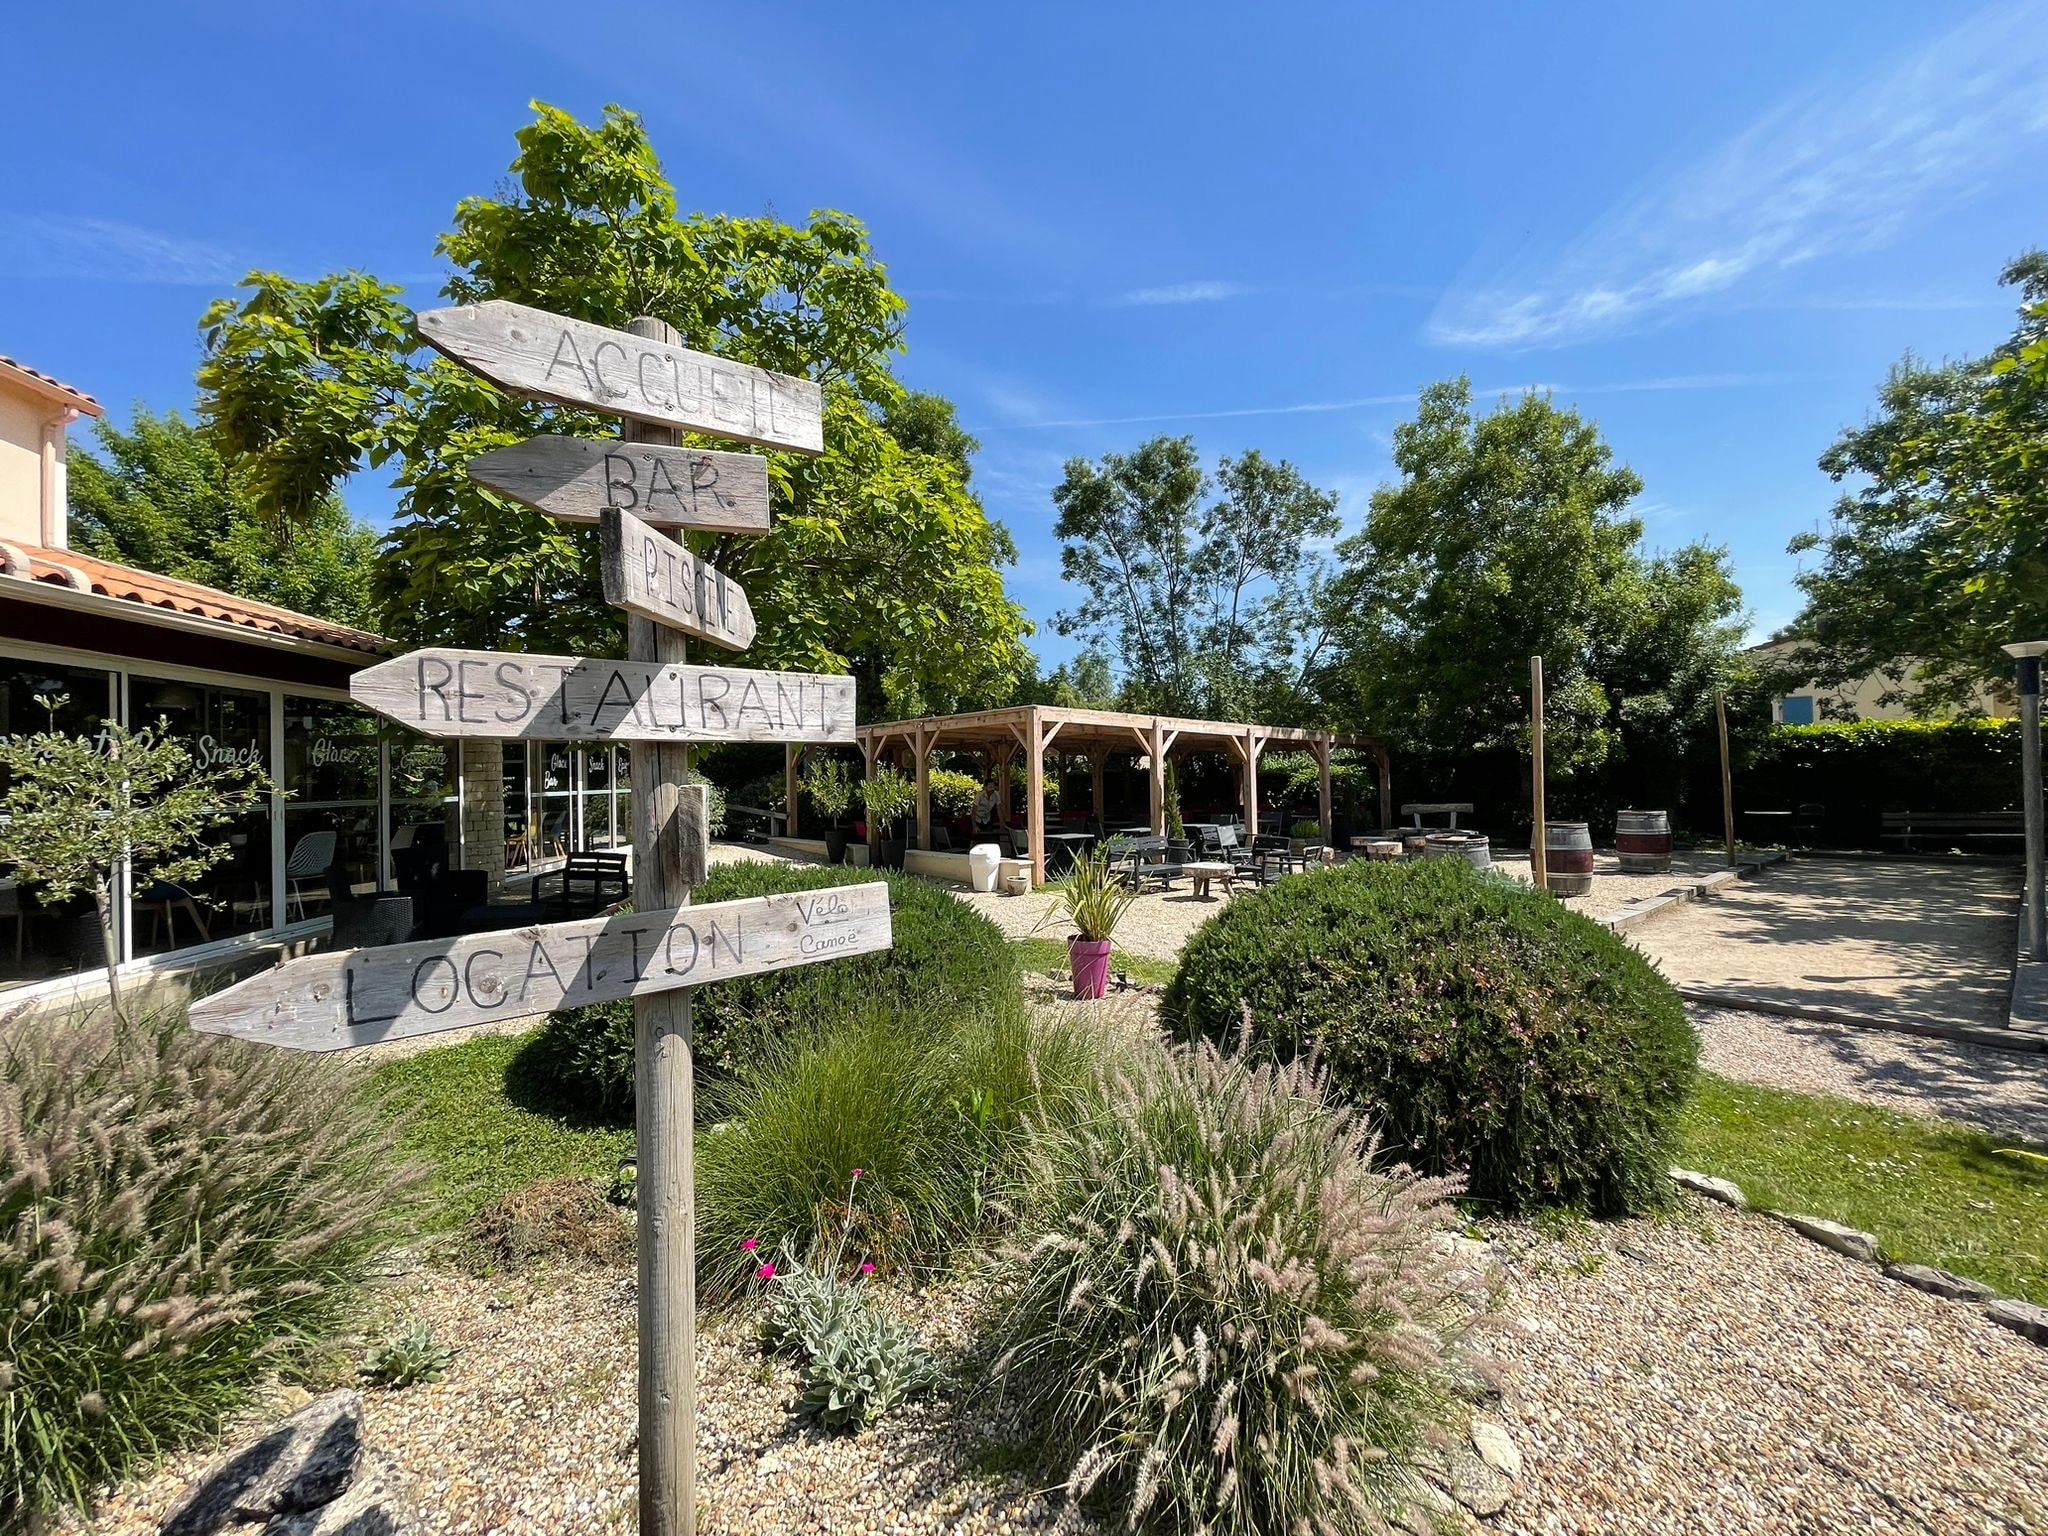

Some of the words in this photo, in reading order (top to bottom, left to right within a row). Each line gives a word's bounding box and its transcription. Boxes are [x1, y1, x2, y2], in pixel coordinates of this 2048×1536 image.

[545, 329, 794, 436] ACCUEIL
[604, 453, 726, 513] BAR
[643, 534, 736, 637] PISCINE
[417, 656, 837, 733] RESTAURANT
[195, 734, 264, 770] Snack
[544, 770, 559, 790] Bar
[796, 894, 849, 925] Vélo
[345, 913, 744, 1027] LOCATION
[800, 928, 859, 954] Canoë
